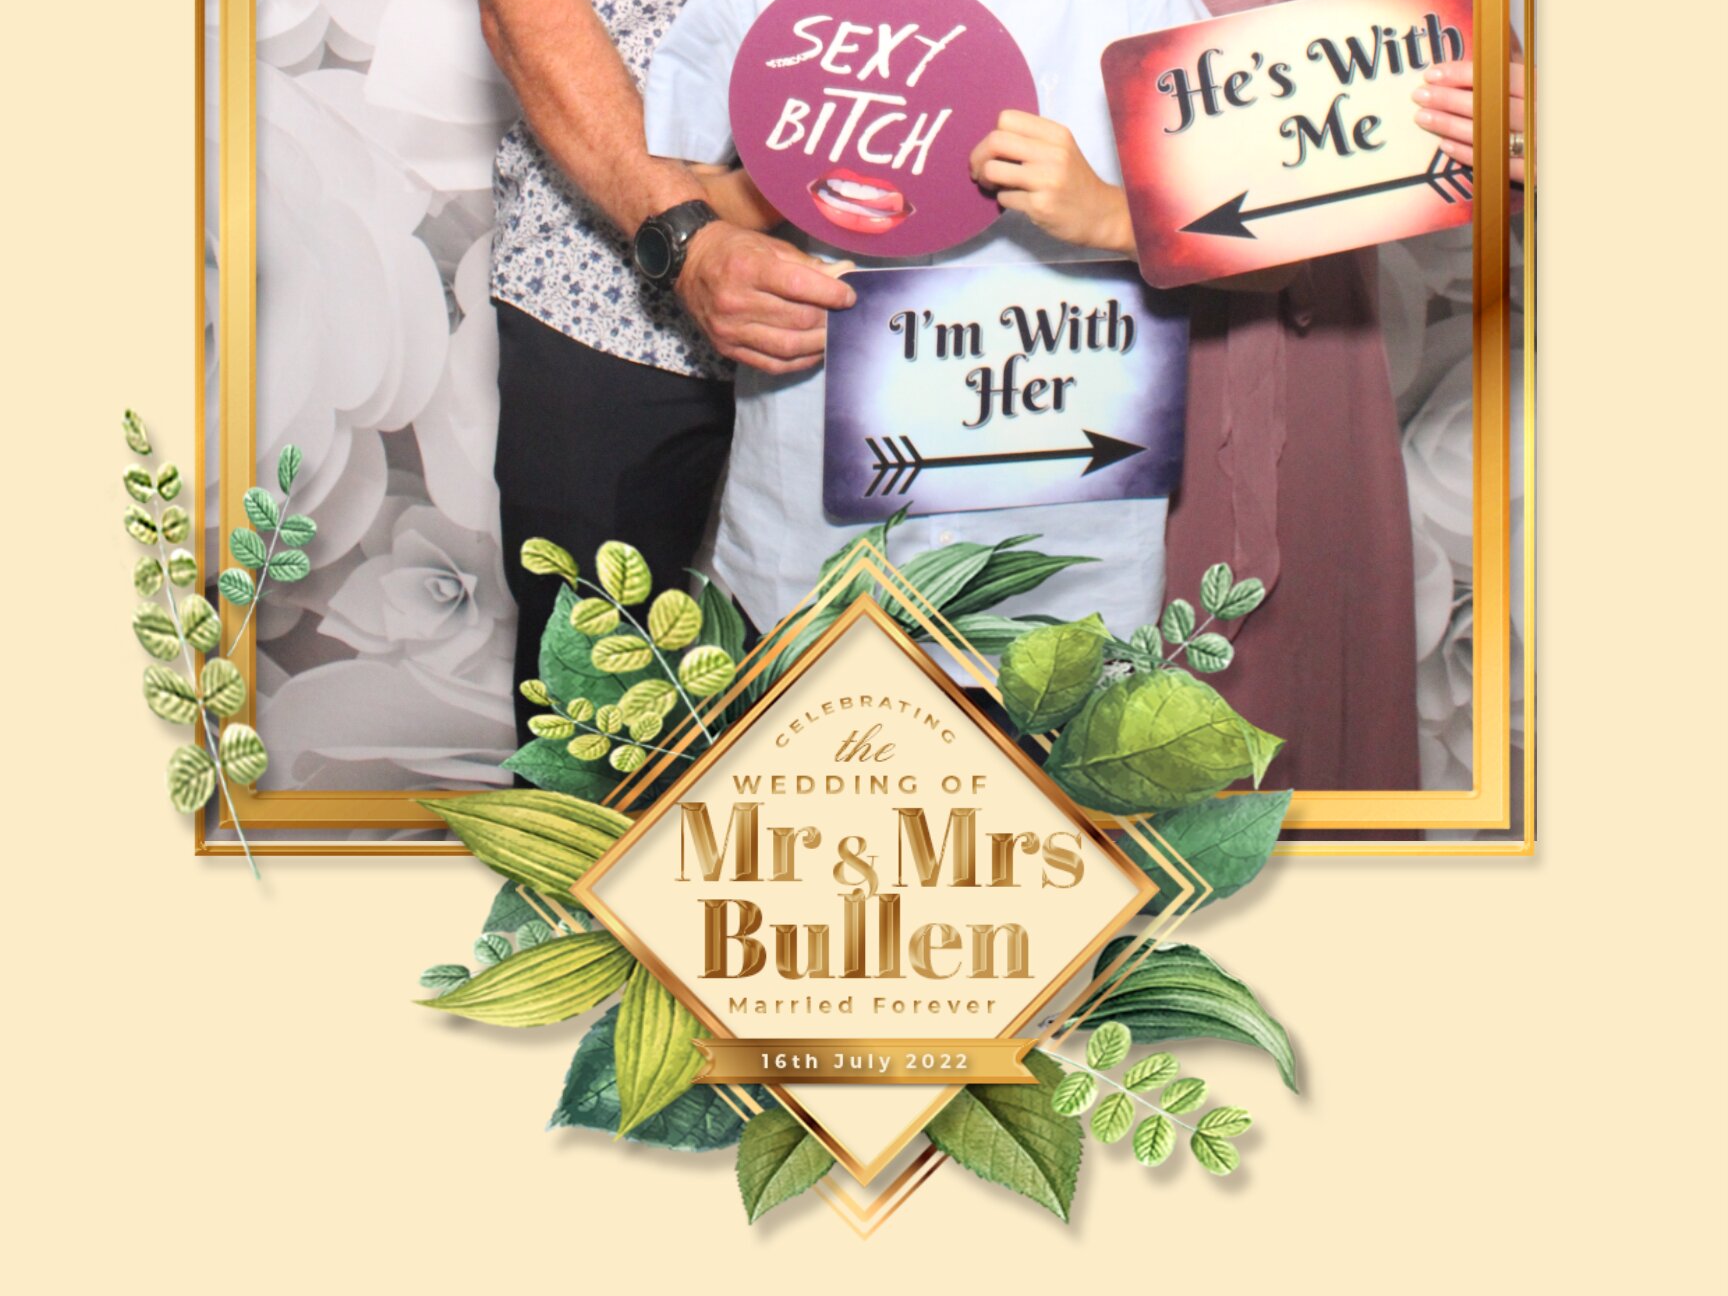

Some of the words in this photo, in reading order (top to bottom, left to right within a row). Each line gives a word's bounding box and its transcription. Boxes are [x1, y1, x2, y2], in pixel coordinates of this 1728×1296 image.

[765, 15, 967, 87] SEXY
[1156, 48, 1296, 135] He's
[1306, 12, 1466, 86] With
[766, 87, 952, 175] BITCH
[1279, 92, 1386, 168] Me
[888, 309, 985, 361] I'm
[999, 299, 1137, 355] With
[962, 353, 1077, 429] Her
